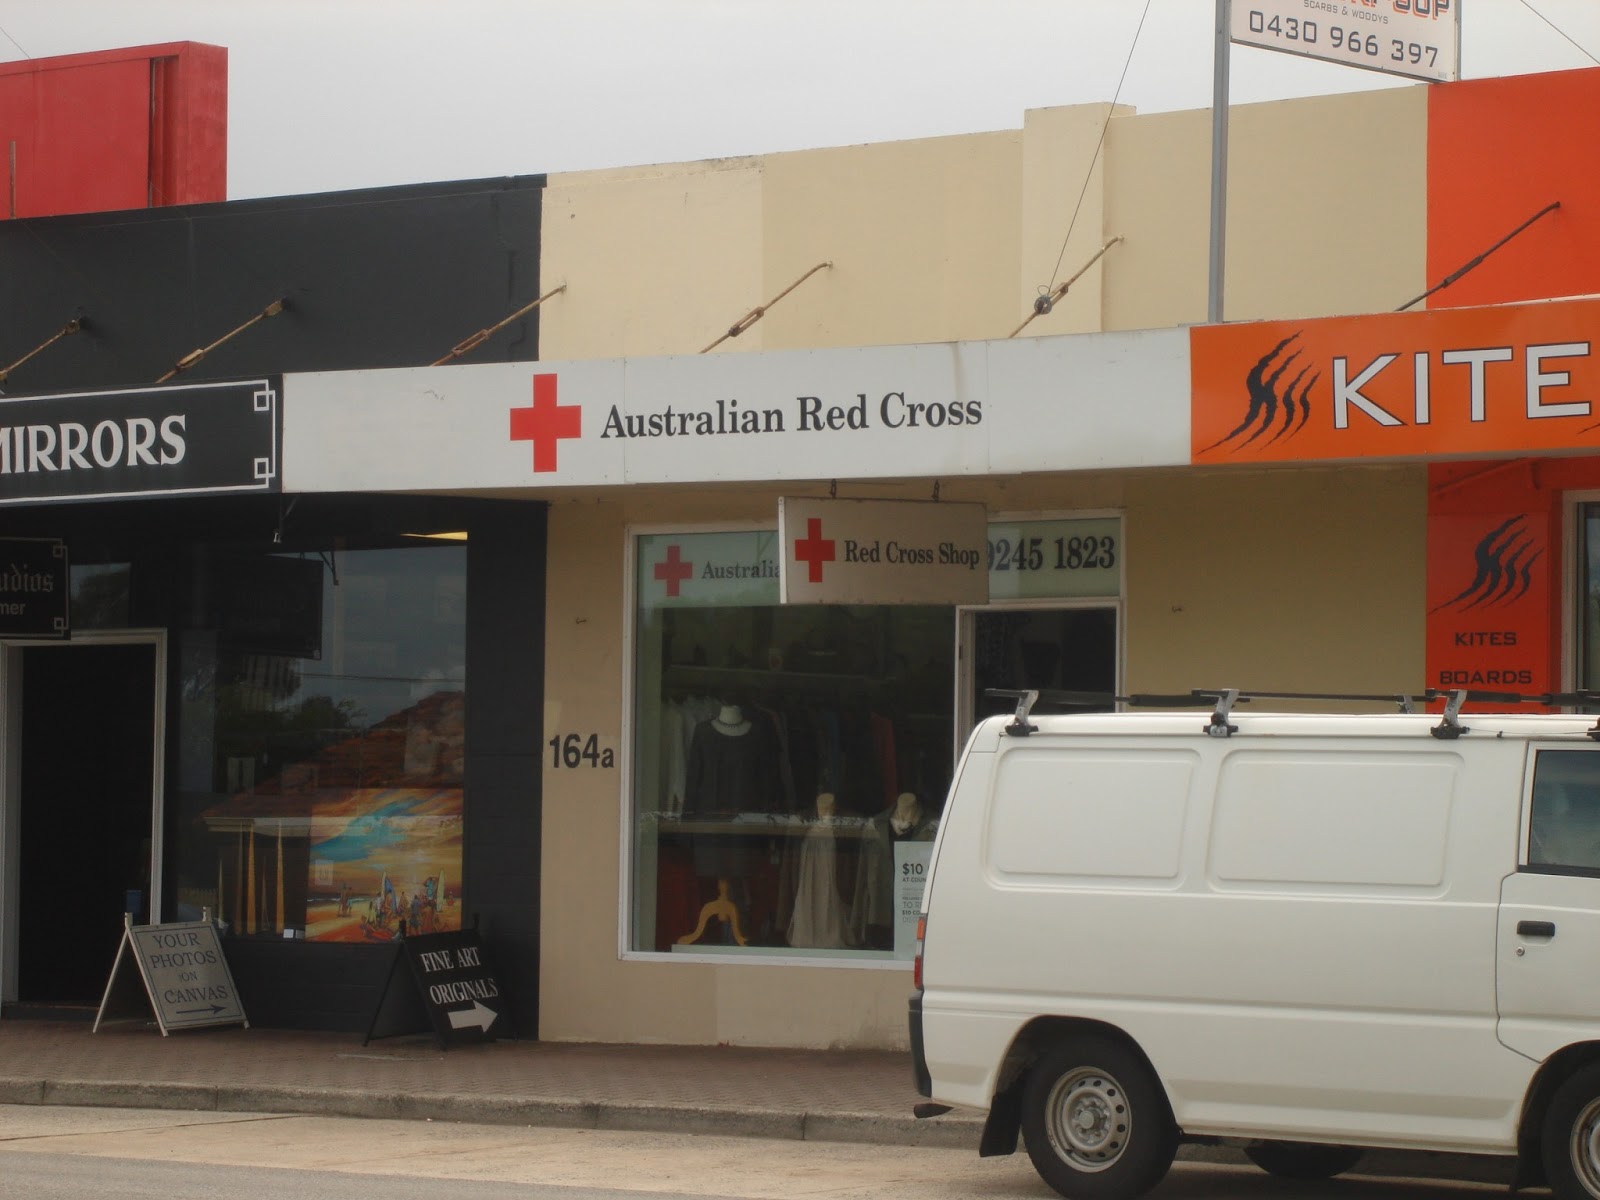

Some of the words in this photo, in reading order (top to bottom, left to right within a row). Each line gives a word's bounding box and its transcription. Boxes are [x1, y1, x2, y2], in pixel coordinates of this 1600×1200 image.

[1303, 0, 1338, 13] SCARBS
[1341, 5, 1349, 16] &
[1351, 9, 1389, 24] WOODYS
[1249, 10, 1318, 44] 0430
[1329, 26, 1379, 57] 966
[1390, 39, 1439, 68] 397
[1332, 341, 1592, 430] KITE
[600, 399, 786, 439] Australian
[796, 393, 870, 432] Red
[880, 391, 983, 429] Cross
[844, 539, 881, 564] Red
[885, 540, 935, 566] Cross
[938, 542, 981, 570] Shop
[1053, 535, 1116, 570] 1823
[1454, 631, 1518, 647] KITES
[1439, 670, 1533, 685] BOARDS
[549, 732, 615, 769] 164a
[902, 863, 923, 875] $10
[152, 931, 201, 949] YOUR
[150, 950, 217, 969] PHOTOS
[420, 950, 455, 973] FINE
[457, 947, 481, 968] ART
[181, 971, 198, 982] ON
[164, 985, 229, 1004] CANVAS
[429, 977, 499, 1005] ORIGINALS
